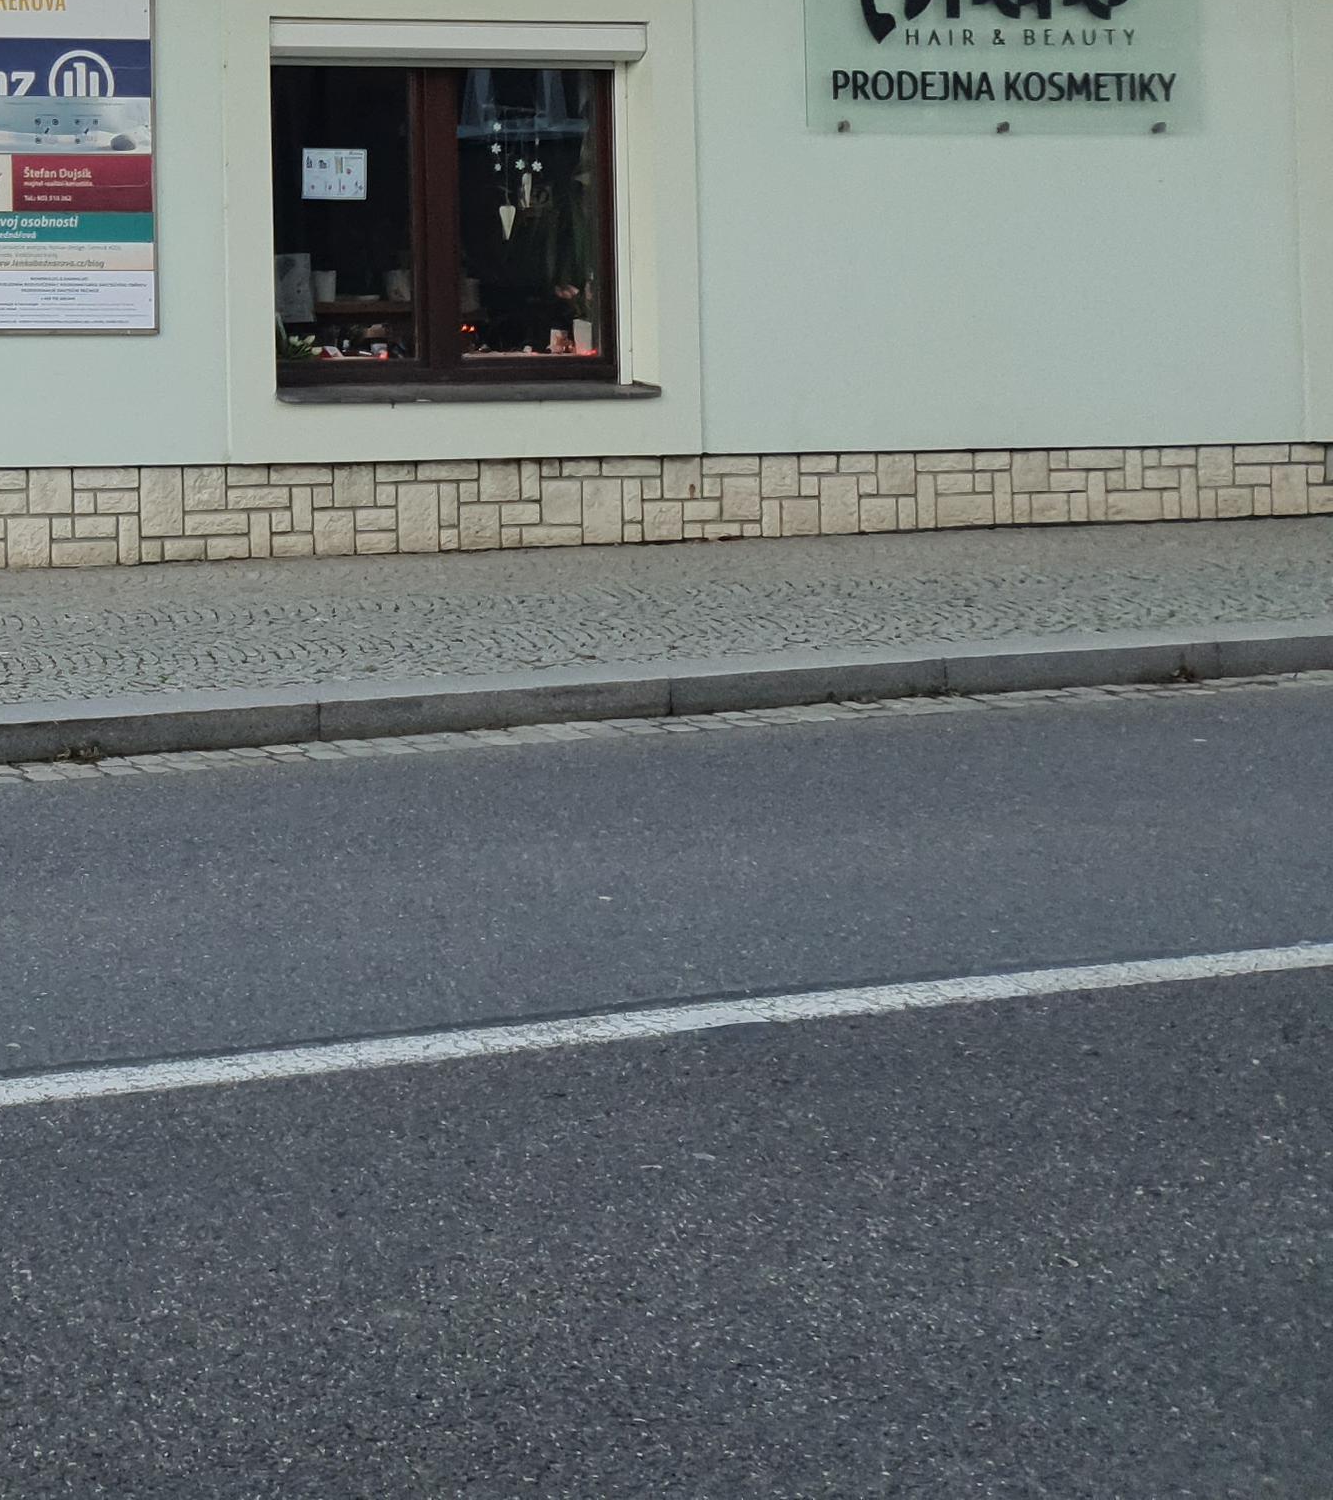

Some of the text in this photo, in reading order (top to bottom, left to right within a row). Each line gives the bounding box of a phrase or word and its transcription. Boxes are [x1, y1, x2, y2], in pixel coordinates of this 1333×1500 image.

[905, 28, 1136, 46] HAIR & BEAUTY
[832, 70, 1177, 102] PRODEJNA KOSMETIKY
[23, 166, 57, 179] Štefan
[21, 216, 79, 228] osobnosti
